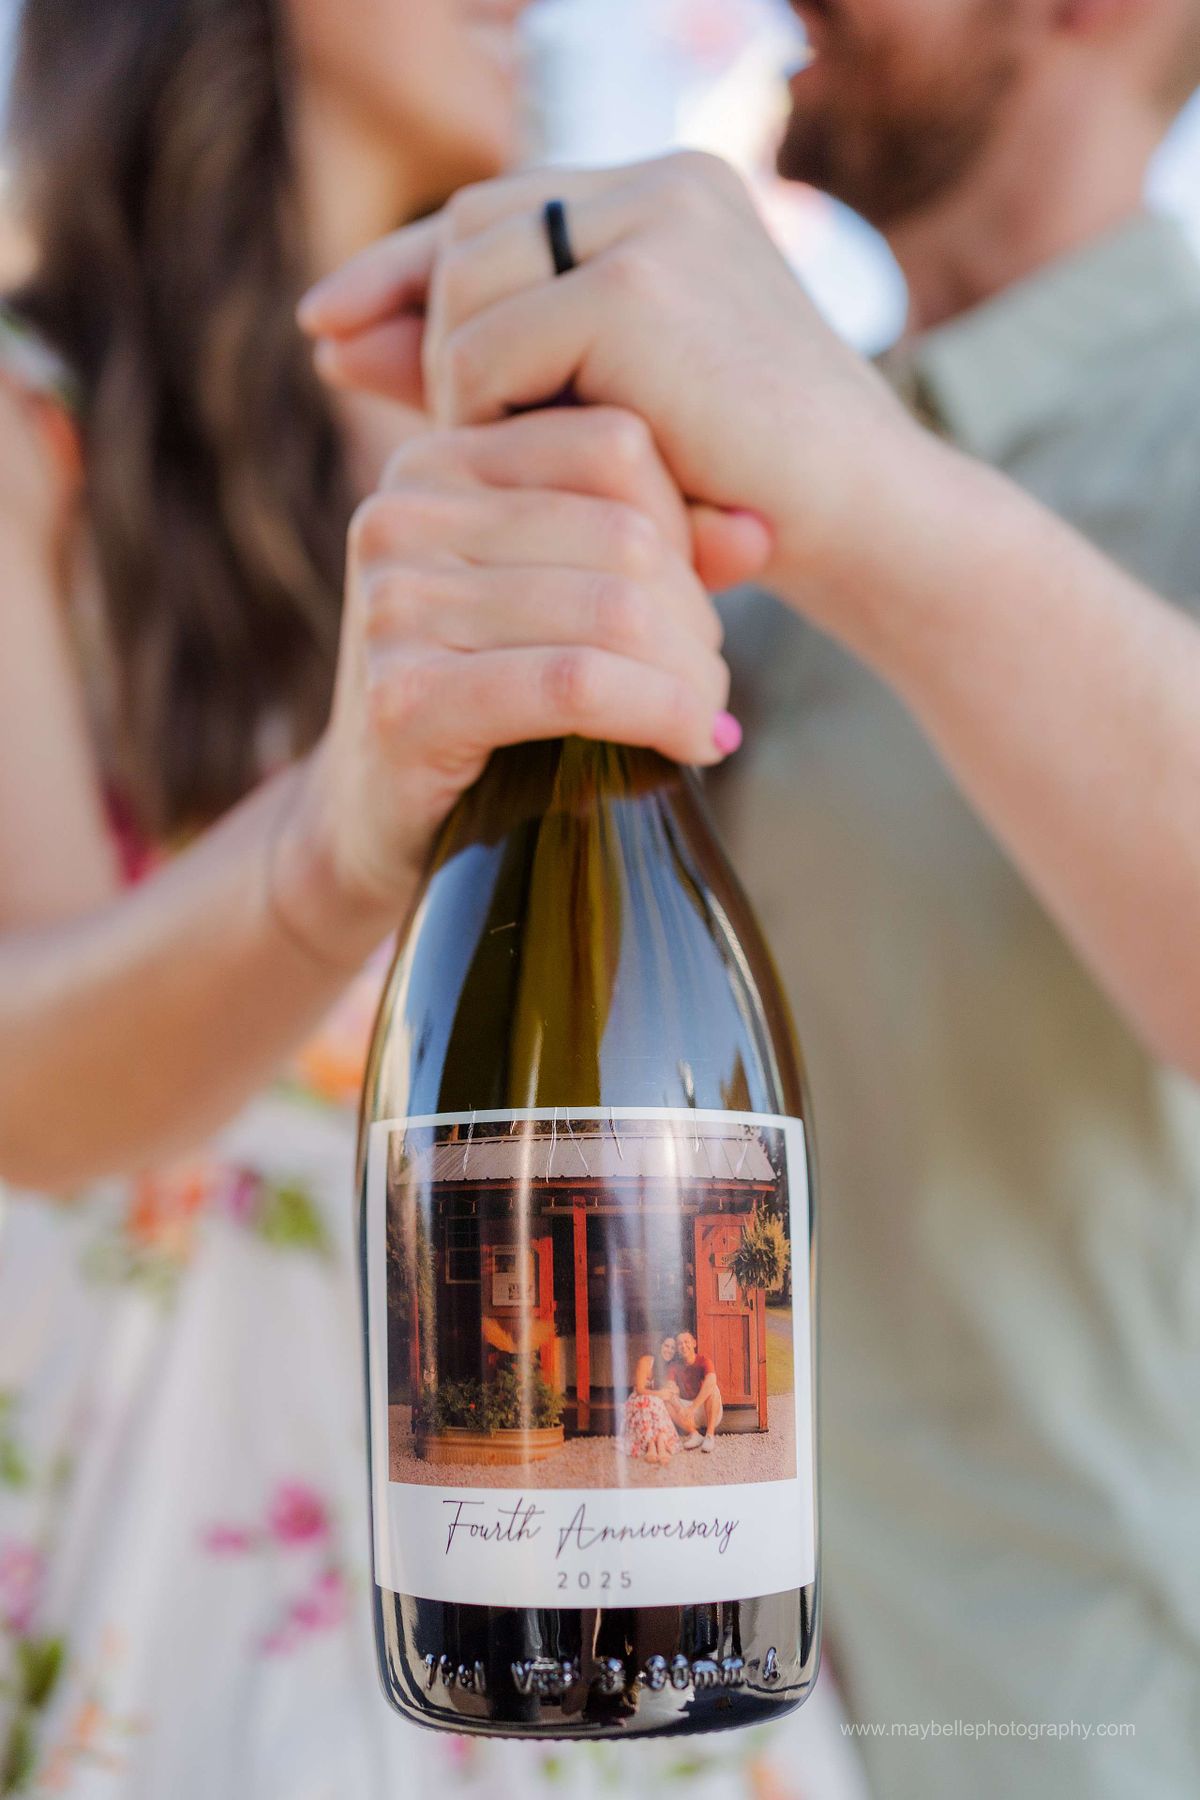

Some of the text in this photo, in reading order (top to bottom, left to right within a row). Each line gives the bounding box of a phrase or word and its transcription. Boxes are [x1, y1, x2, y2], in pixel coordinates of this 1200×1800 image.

[442, 1497, 739, 1559] Fourth Anniversary
[557, 1571, 632, 1589] 2025
